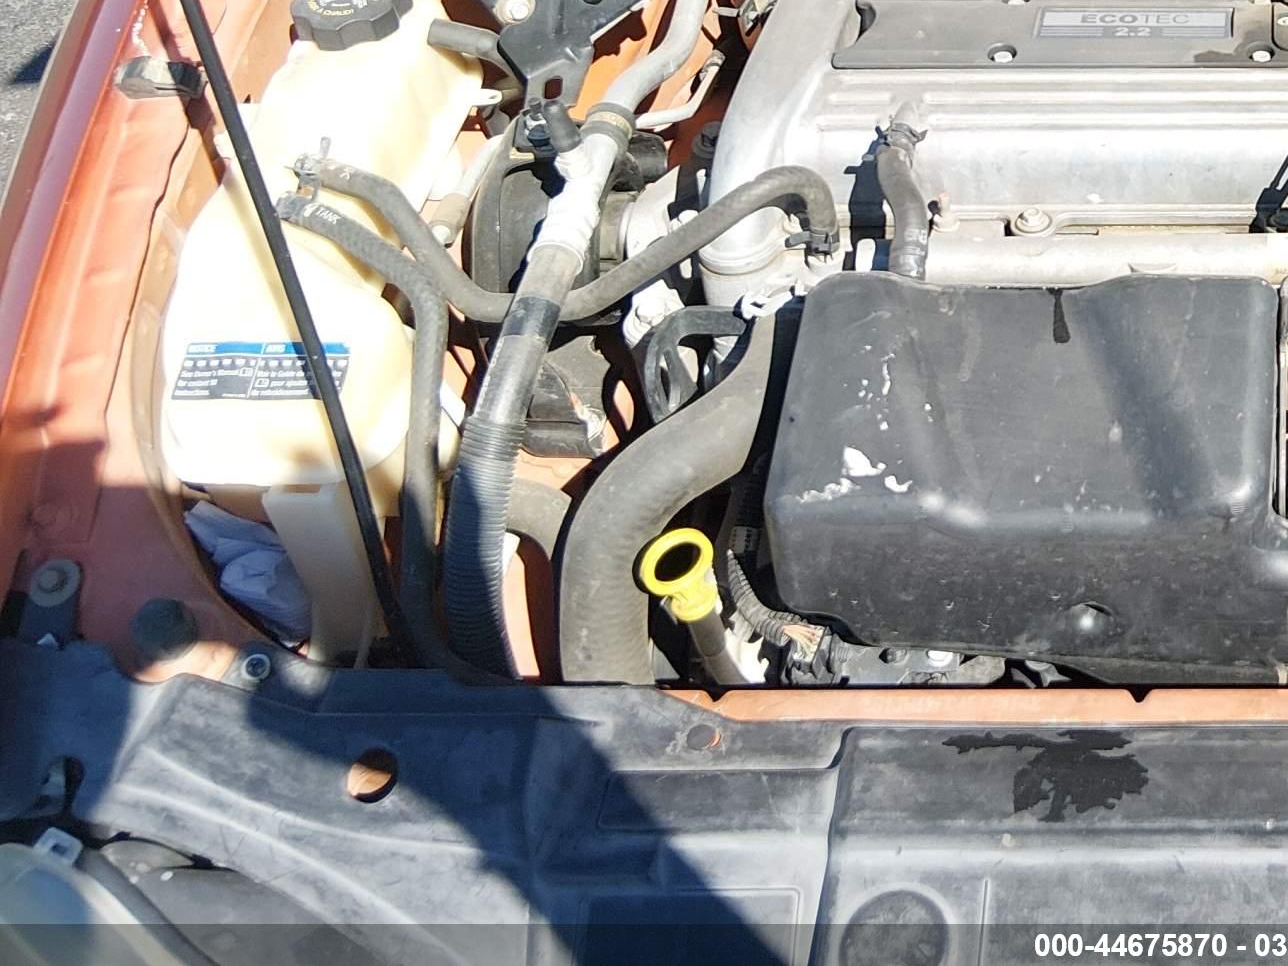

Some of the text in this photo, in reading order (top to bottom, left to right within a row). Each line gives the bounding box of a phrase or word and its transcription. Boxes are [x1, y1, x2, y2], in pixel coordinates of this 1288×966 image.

[1081, 13, 1191, 24] ECOTEC
[1114, 27, 1151, 37] 2.2
[316, 207, 342, 224] TANK
